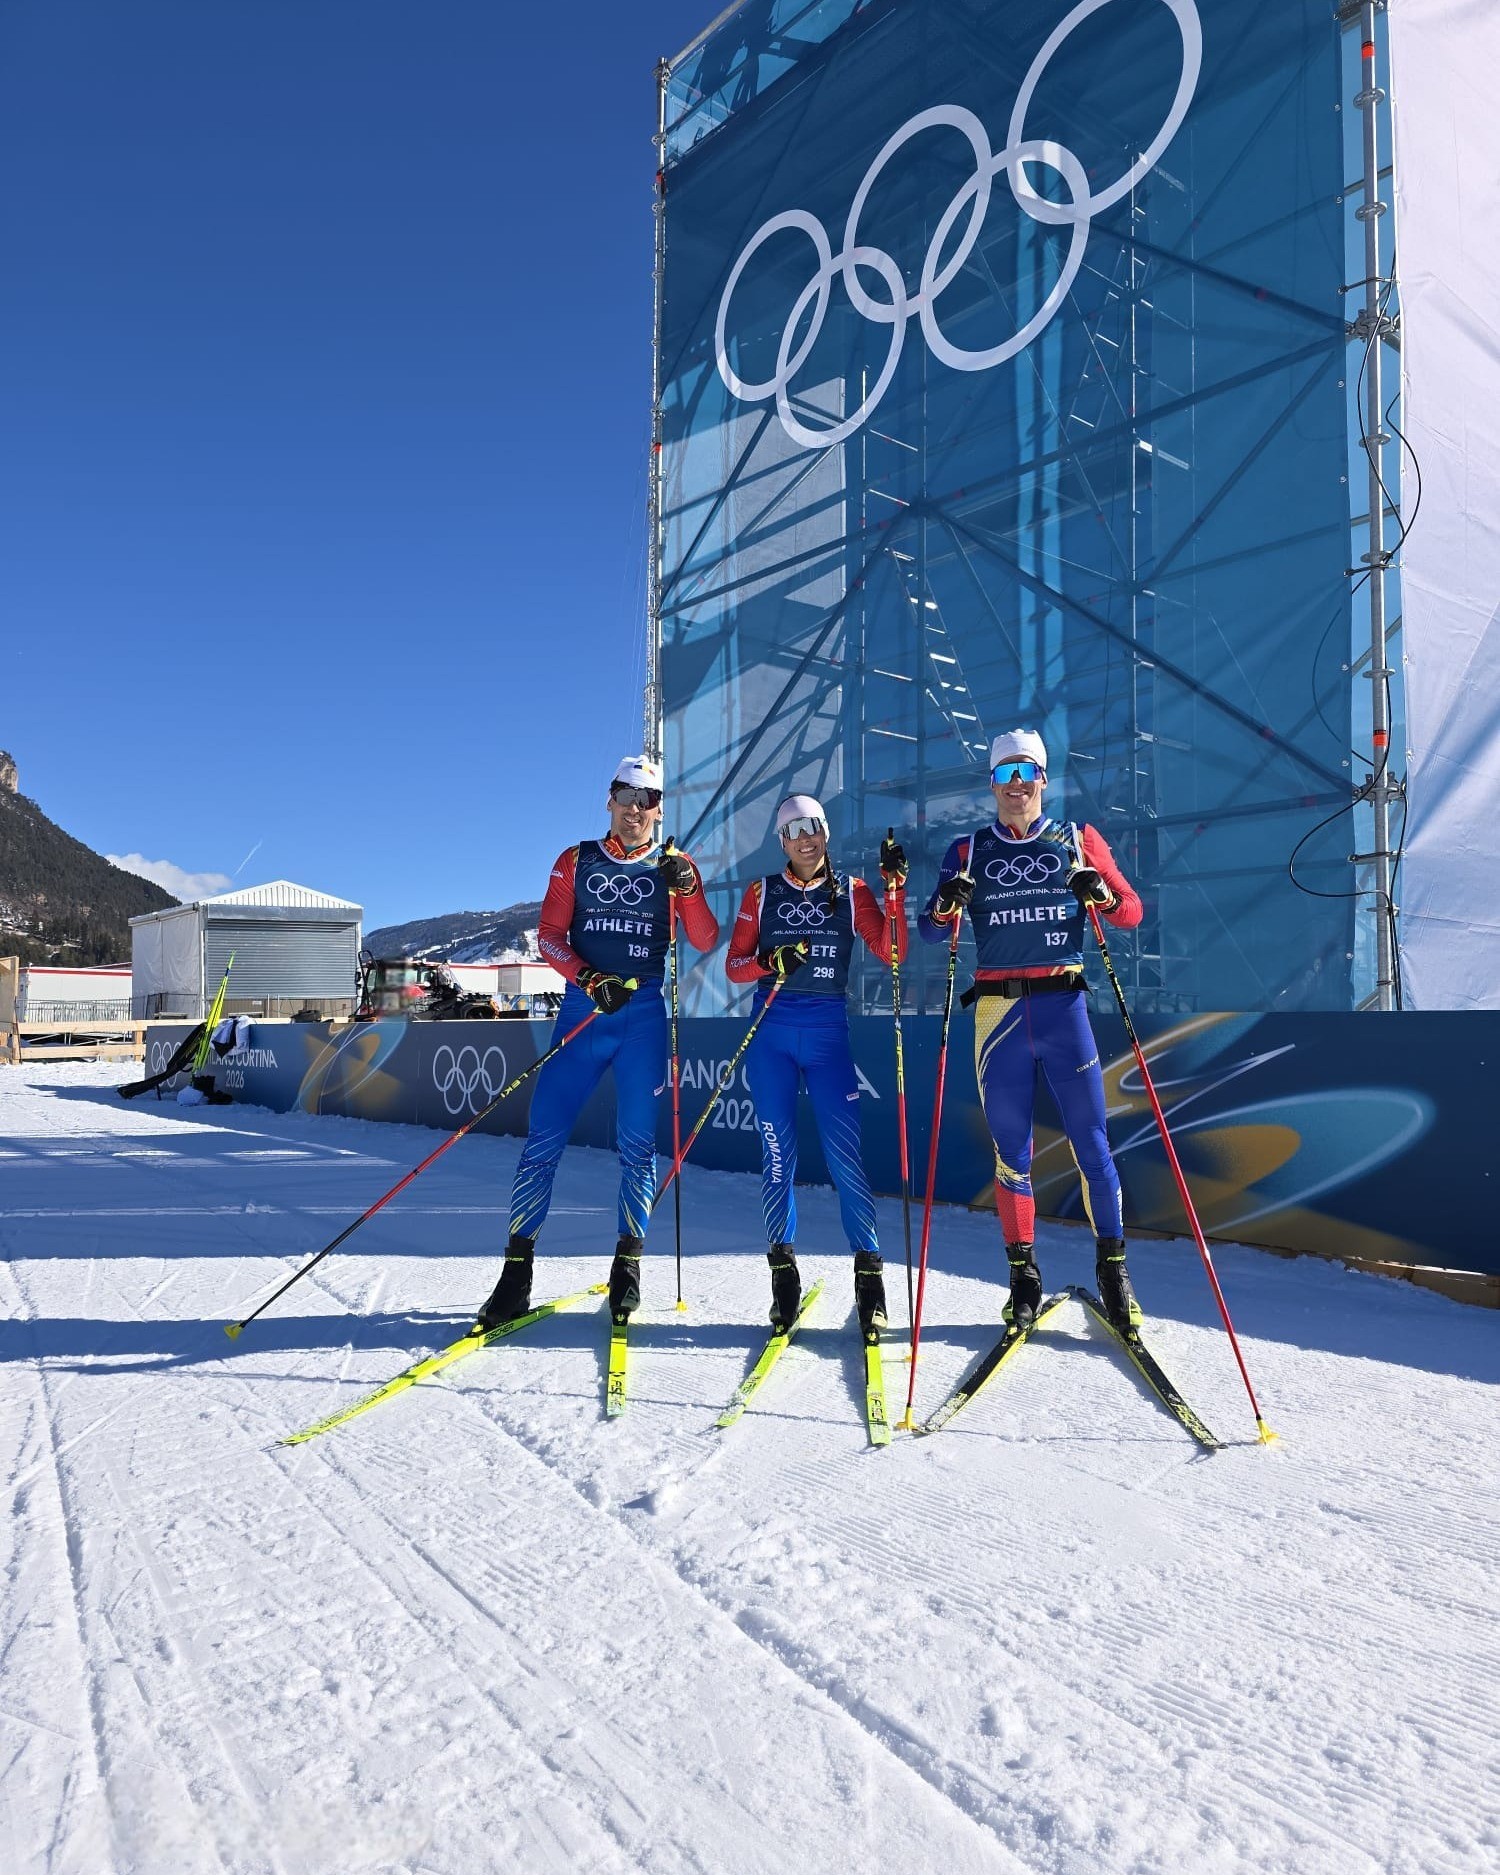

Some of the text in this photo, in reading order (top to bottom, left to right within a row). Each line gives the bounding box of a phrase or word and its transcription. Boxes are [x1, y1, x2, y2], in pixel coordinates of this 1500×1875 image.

[985, 891, 1015, 901] MILANO
[1015, 888, 1050, 896] CORTINA
[989, 905, 1066, 926] ATHLETE
[584, 917, 652, 937] ATHLETE
[1045, 932, 1068, 946] 137
[539, 938, 571, 962] ROMANIA
[628, 943, 650, 958] 136
[1101, 948, 1113, 975] LEKI
[813, 966, 835, 979] 298
[226, 1069, 245, 1089] 2026
[666, 1058, 736, 1091] LANO
[500, 1072, 529, 1098] LEKI
[761, 1120, 782, 1184] ROMANIA
